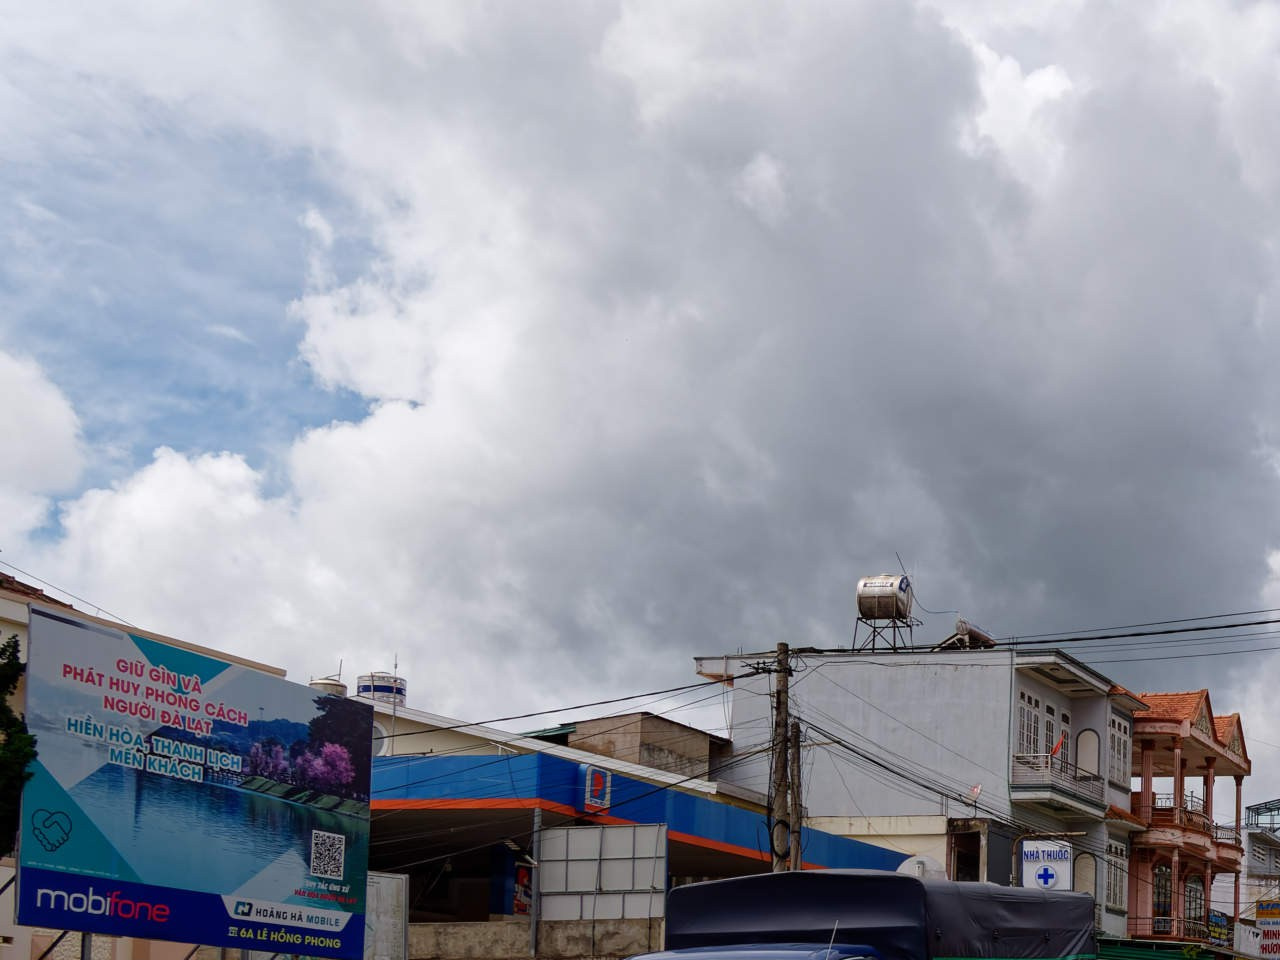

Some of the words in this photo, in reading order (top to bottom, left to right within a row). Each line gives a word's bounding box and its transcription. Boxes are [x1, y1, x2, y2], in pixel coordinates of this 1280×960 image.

[116, 659, 144, 677] GIỮ
[150, 667, 177, 687] GÌN
[181, 675, 202, 694] VÀ
[63, 664, 104, 687] PHÁT
[109, 676, 140, 696] HUY
[145, 687, 200, 712] PHONG
[205, 702, 248, 725] CÁCH
[104, 695, 155, 720] NGƯỜI
[161, 709, 182, 727] ĐÀ
[187, 720, 213, 736] LẠT
[67, 715, 104, 738] HIỀN
[109, 725, 149, 750] HÒA,
[153, 738, 204, 761] THANH
[208, 749, 241, 771] LỊCH
[109, 746, 143, 767] MẾN
[148, 756, 203, 781] KHÁCH
[36, 886, 170, 922] mobifone
[255, 906, 288, 920] HOÀNG
[290, 907, 304, 922] HÀ
[306, 914, 341, 927] MOBILE
[240, 927, 254, 939] 6A
[257, 926, 268, 940] LÊ
[270, 927, 302, 943] HỒNG
[304, 935, 341, 948] PHONG
